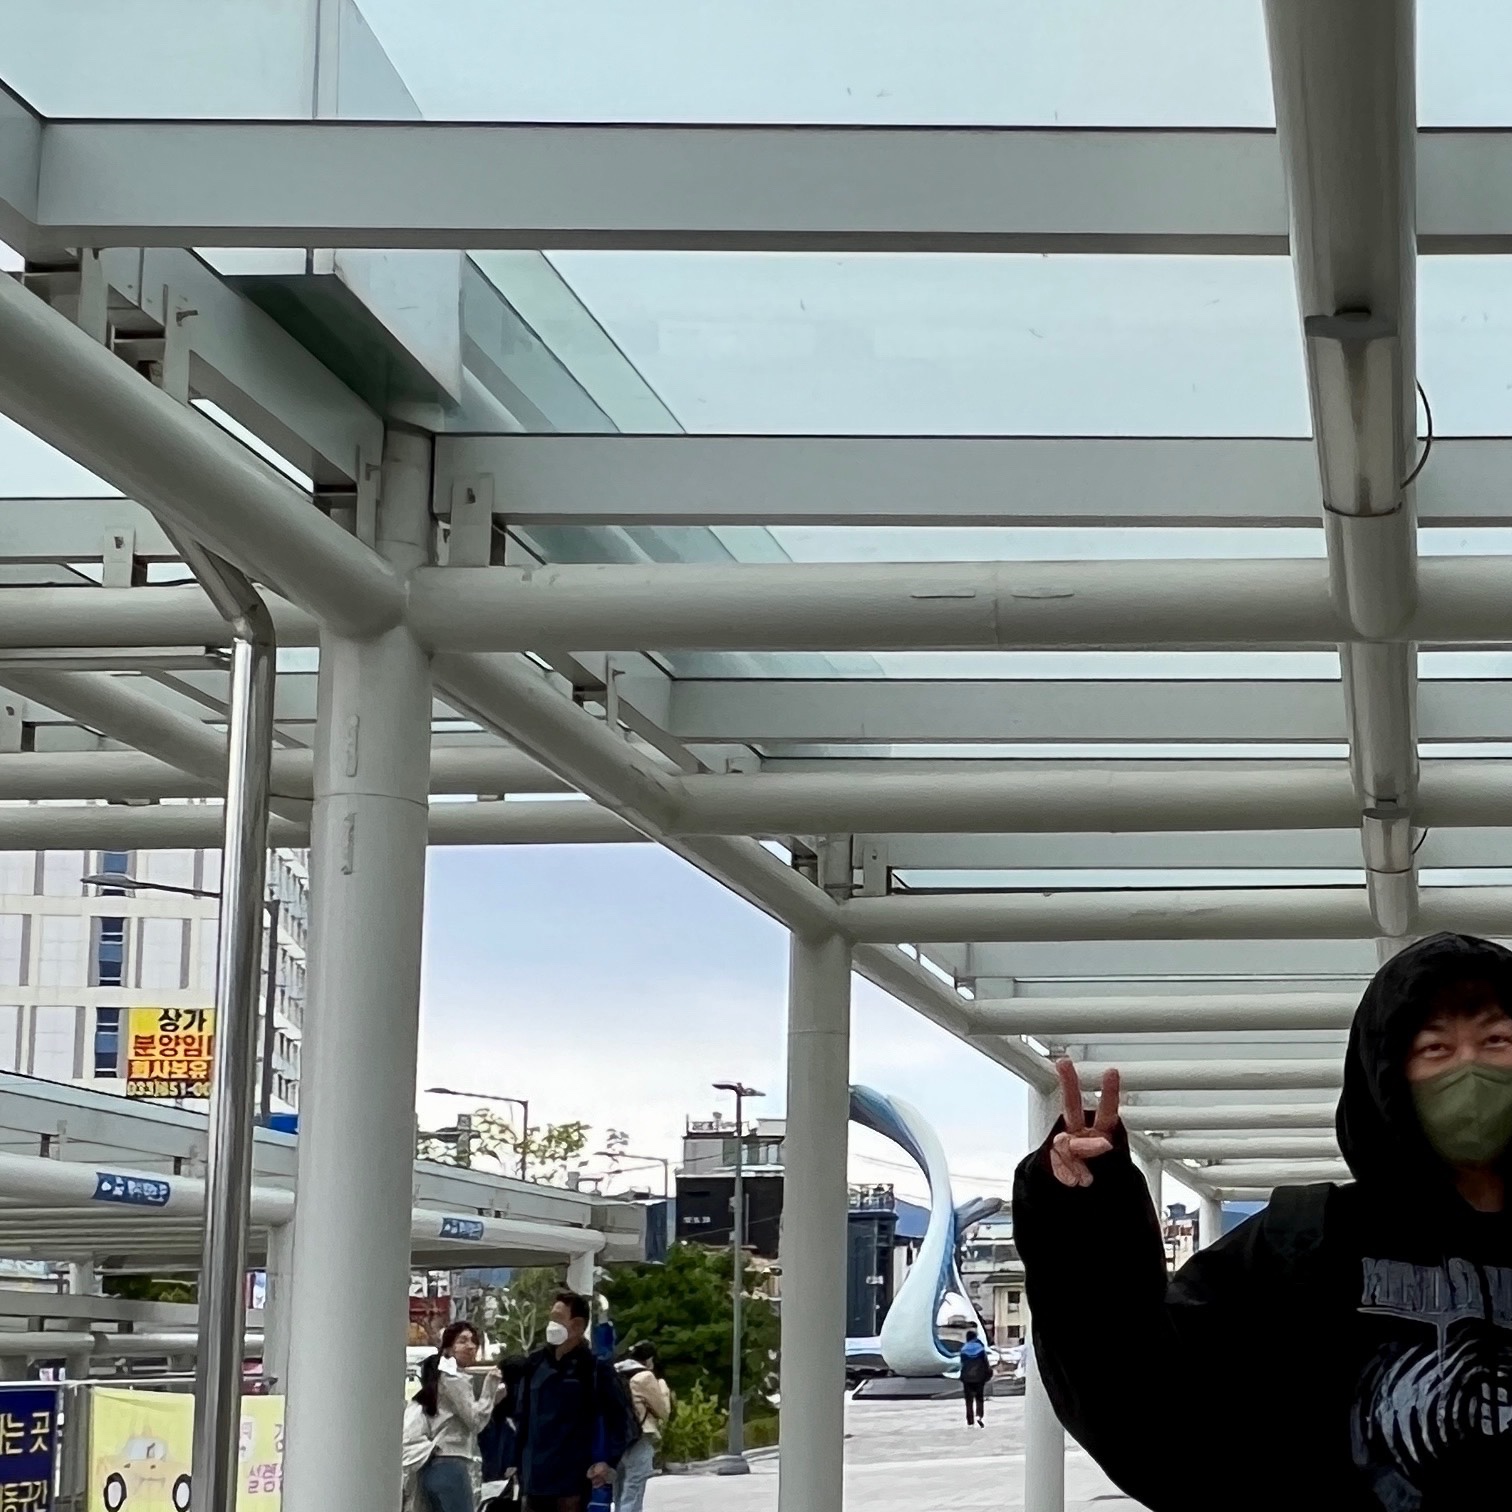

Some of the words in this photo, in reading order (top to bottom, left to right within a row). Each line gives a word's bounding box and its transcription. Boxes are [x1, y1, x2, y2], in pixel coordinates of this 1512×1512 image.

[158, 1008, 207, 1032] 상가
[0, 1412, 24, 1455] 는
[29, 1411, 50, 1453] 곳
